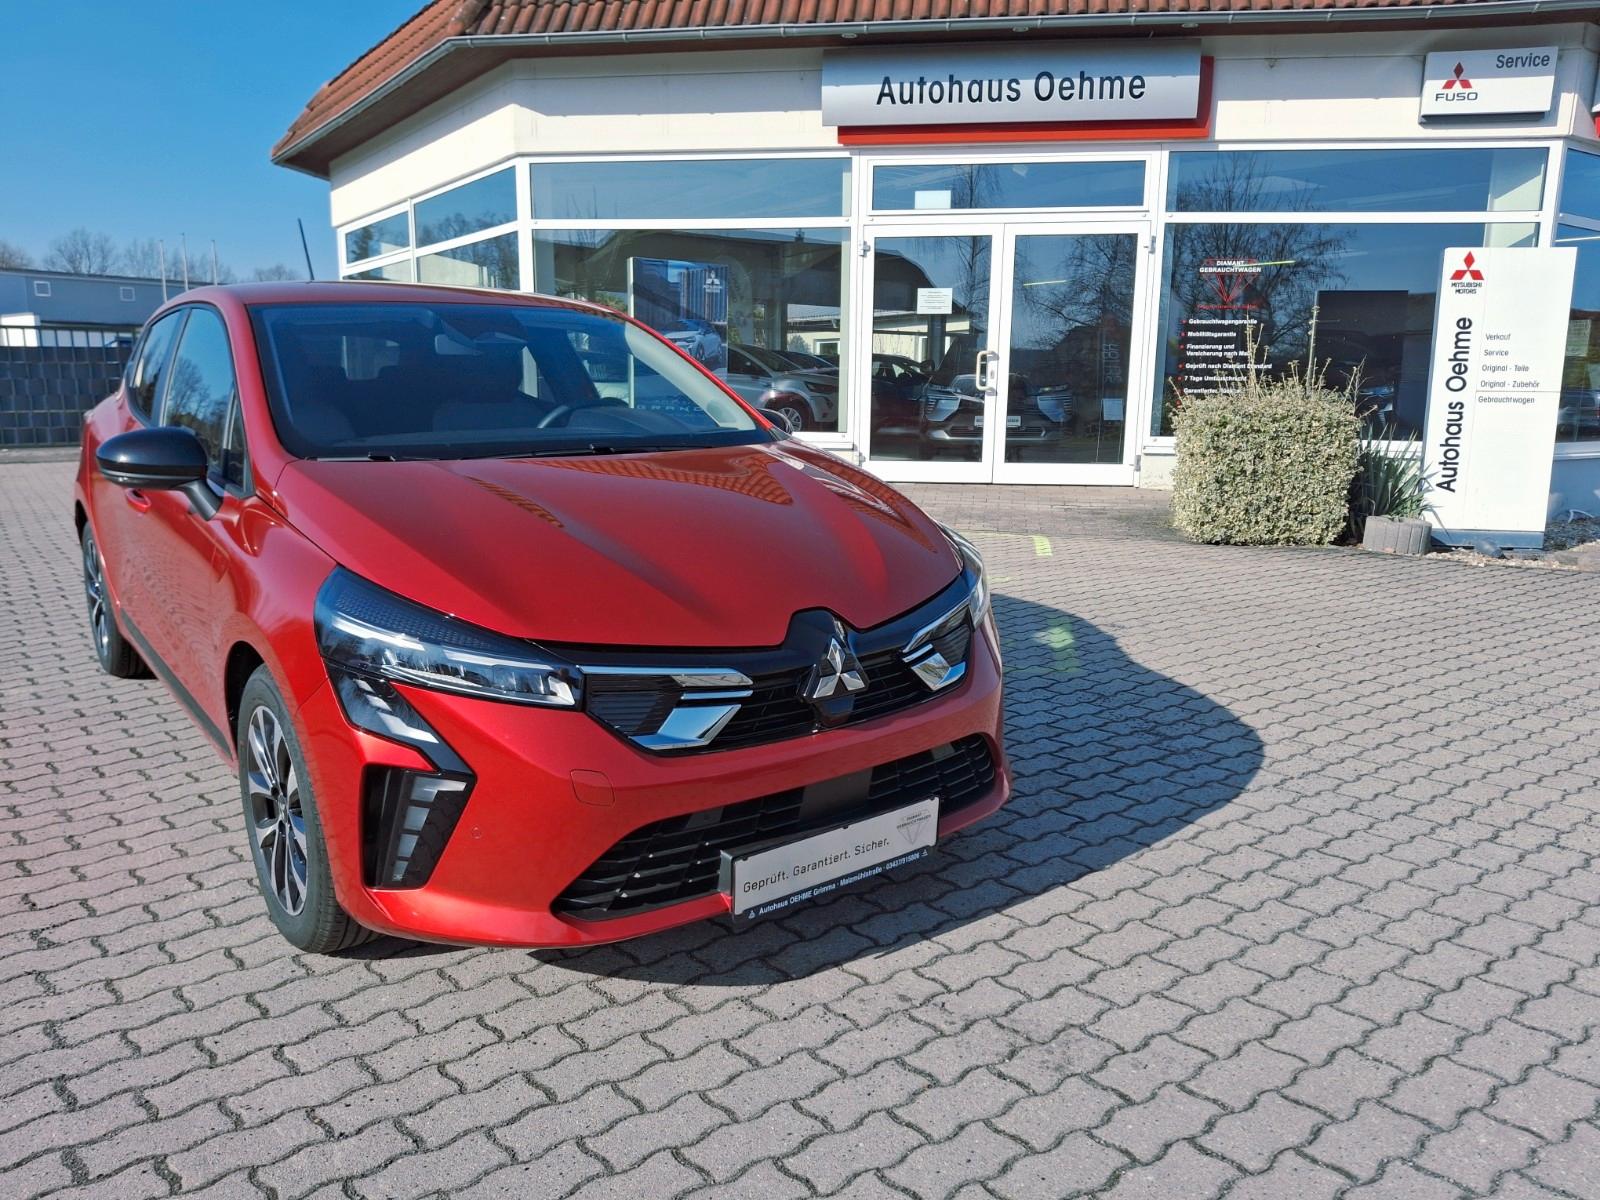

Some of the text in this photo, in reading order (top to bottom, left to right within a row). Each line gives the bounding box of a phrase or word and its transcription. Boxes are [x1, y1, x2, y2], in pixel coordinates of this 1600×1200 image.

[1496, 52, 1551, 69] Service
[876, 71, 1146, 105] Autohaus Oehme
[1435, 92, 1479, 102] FUSO
[1485, 333, 1512, 341] Verkauf
[1483, 349, 1509, 357] Service
[1481, 364, 1508, 373] Original
[1514, 364, 1529, 372] Teile
[1480, 380, 1506, 389] Original
[1512, 380, 1540, 388] Zubehör
[1436, 317, 1473, 492] Autohaus Oehme
[1478, 396, 1535, 405] Gebrauchtwagen
[743, 837, 890, 893] Geprüft. Garantiert. Sicher.
[758, 899, 789, 915] Autohaus
[789, 889, 813, 905] OEHME
[813, 882, 837, 897] Grimma
